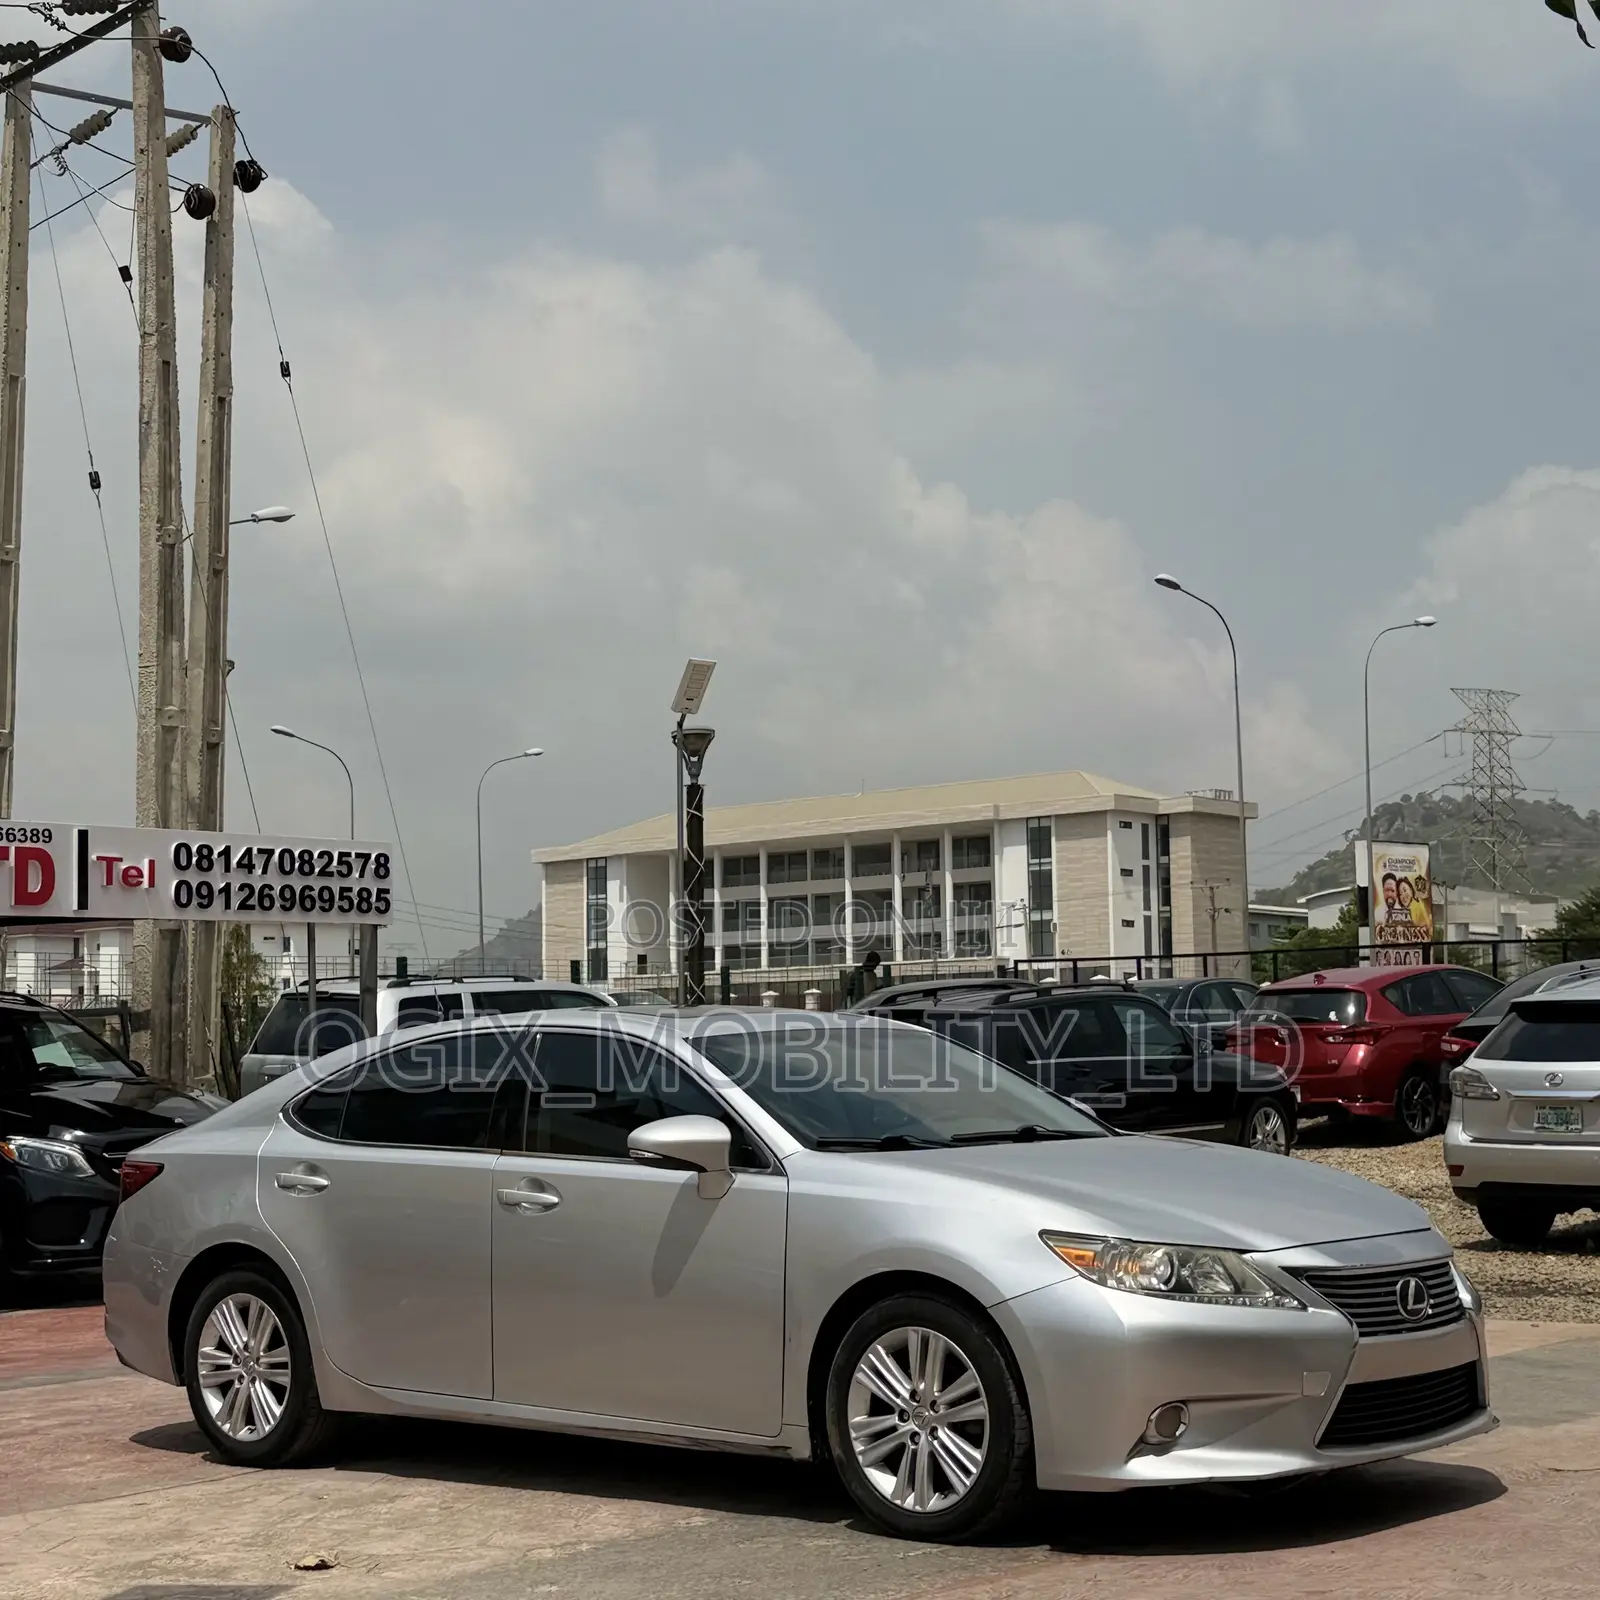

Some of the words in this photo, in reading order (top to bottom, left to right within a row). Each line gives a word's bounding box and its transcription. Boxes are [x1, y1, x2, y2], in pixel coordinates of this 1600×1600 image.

[0, 846, 56, 906] D
[95, 856, 155, 888] Tel
[173, 842, 391, 880] 08147082578
[173, 879, 391, 914] 09126969585
